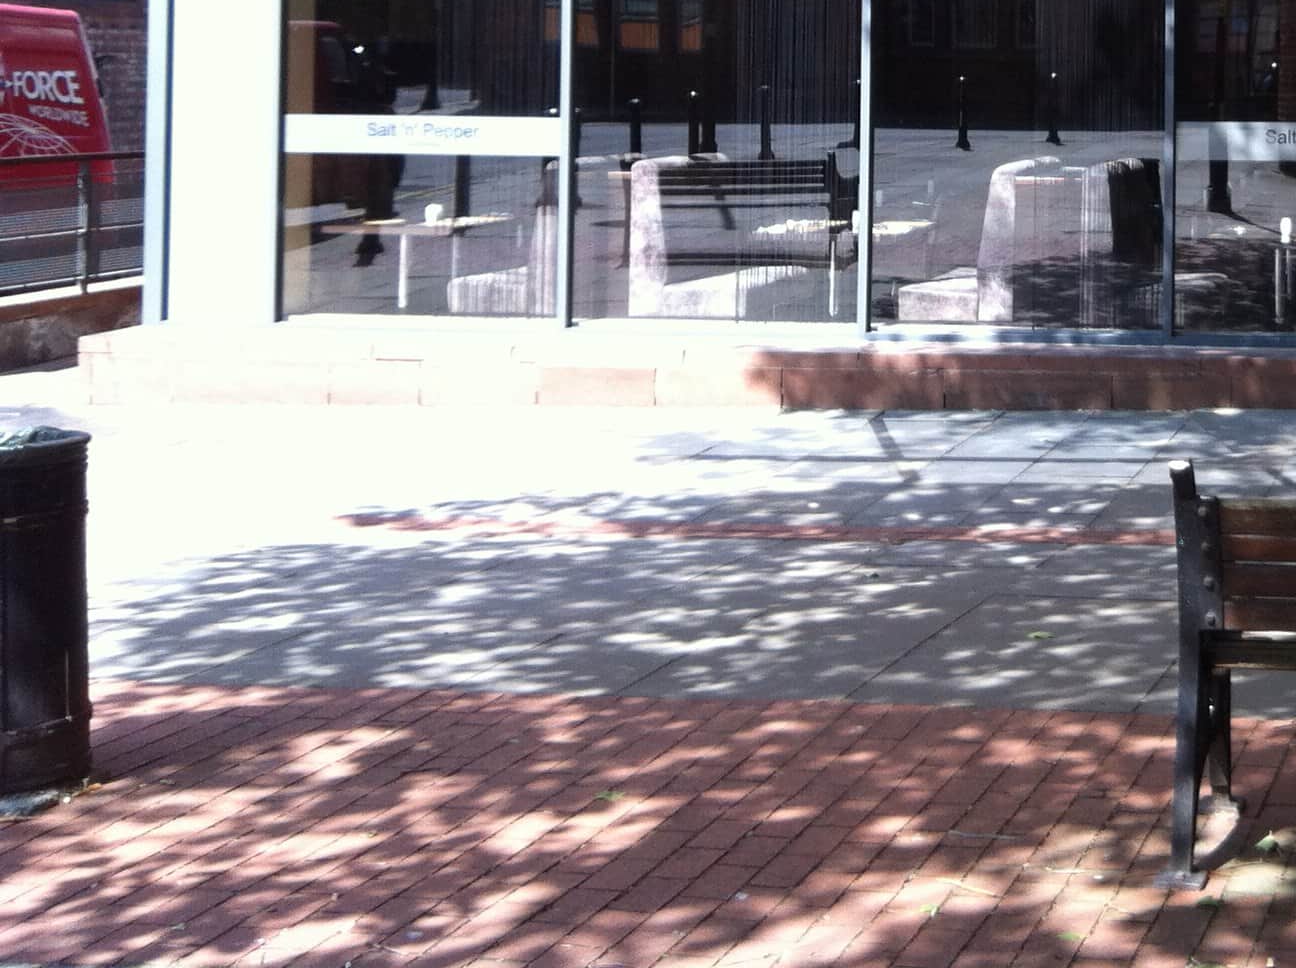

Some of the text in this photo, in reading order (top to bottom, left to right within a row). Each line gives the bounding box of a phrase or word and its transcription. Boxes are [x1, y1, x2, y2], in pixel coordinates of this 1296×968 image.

[366, 122, 396, 136] Salt
[423, 123, 480, 140] Pepper
[1265, 129, 1296, 144] Salt
